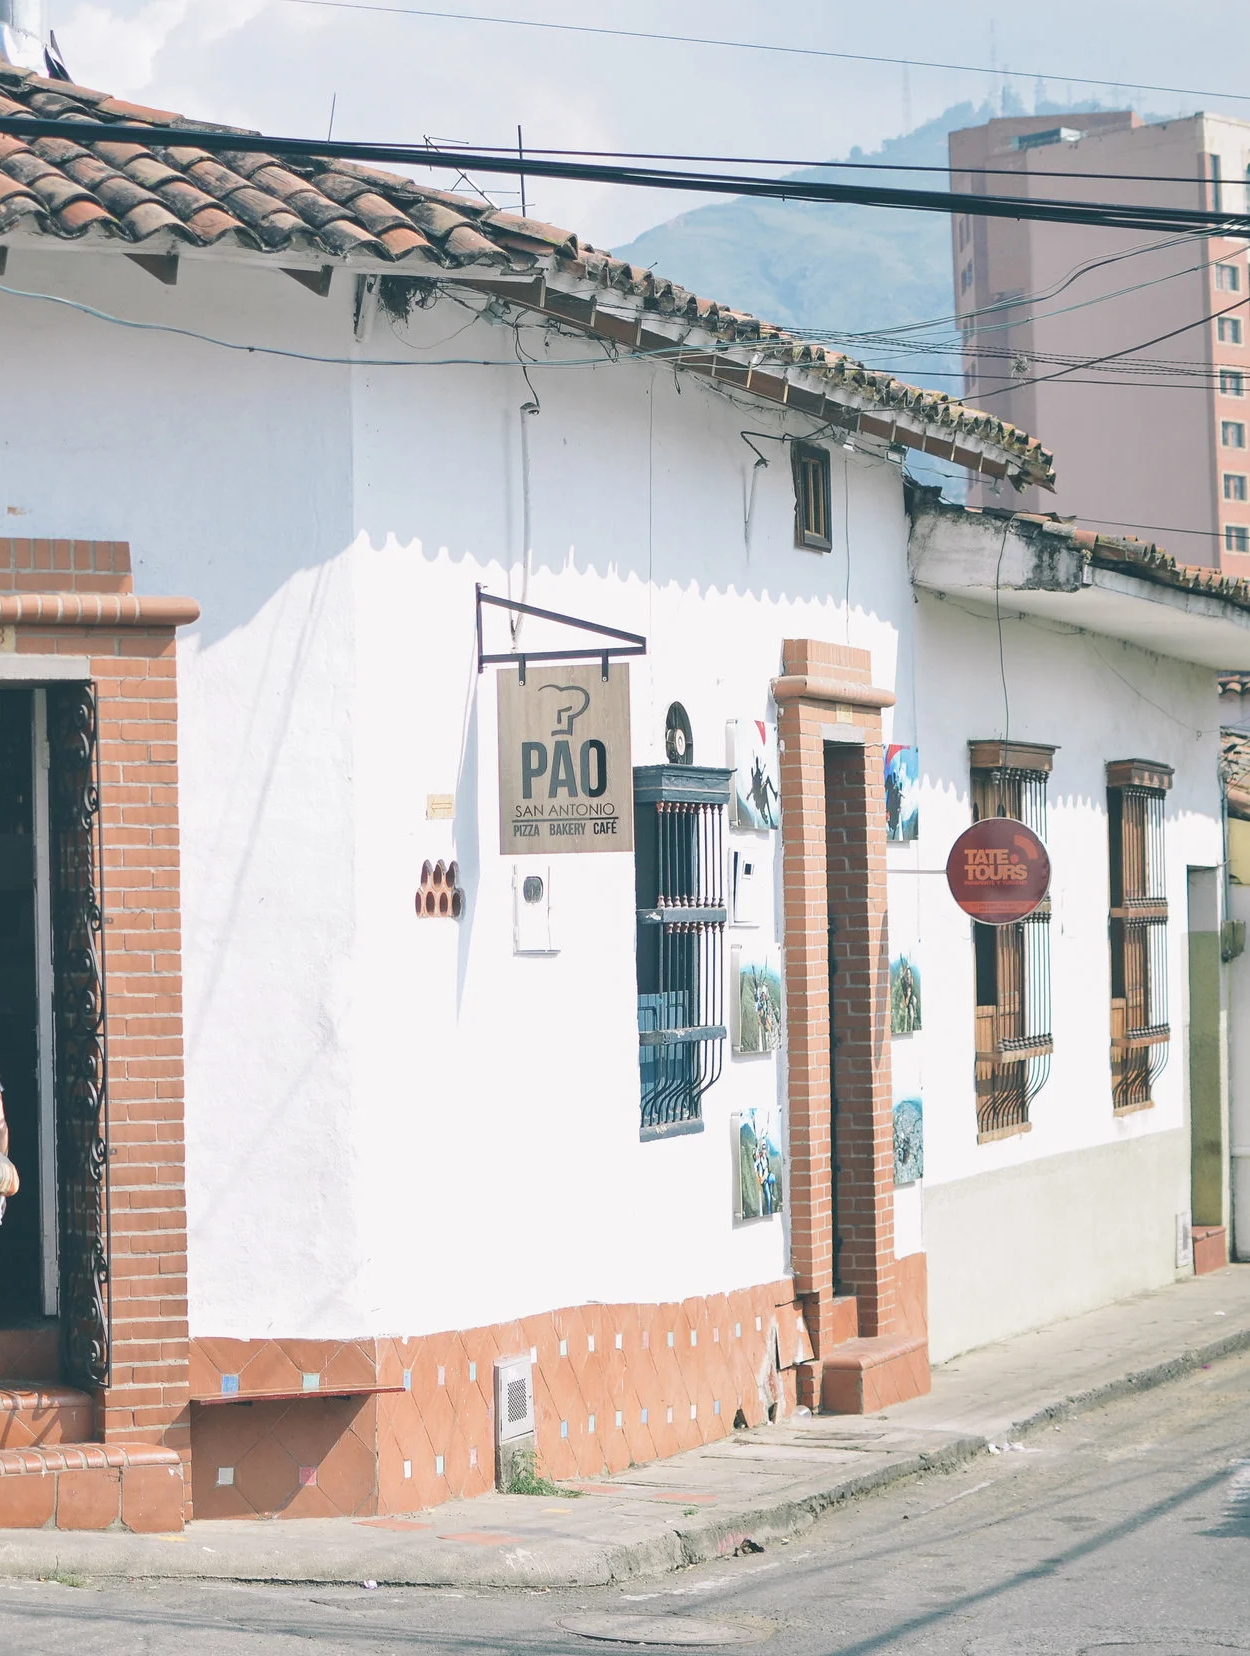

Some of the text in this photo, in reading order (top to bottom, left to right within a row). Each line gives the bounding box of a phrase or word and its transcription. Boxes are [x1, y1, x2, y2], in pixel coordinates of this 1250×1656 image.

[521, 739, 607, 799] PAO
[515, 802, 615, 818] SAN ANTONIO
[513, 820, 617, 837] PIZZA BAKERY CAFÉ
[964, 849, 1009, 864] TATE
[964, 864, 1028, 881] TOURS
